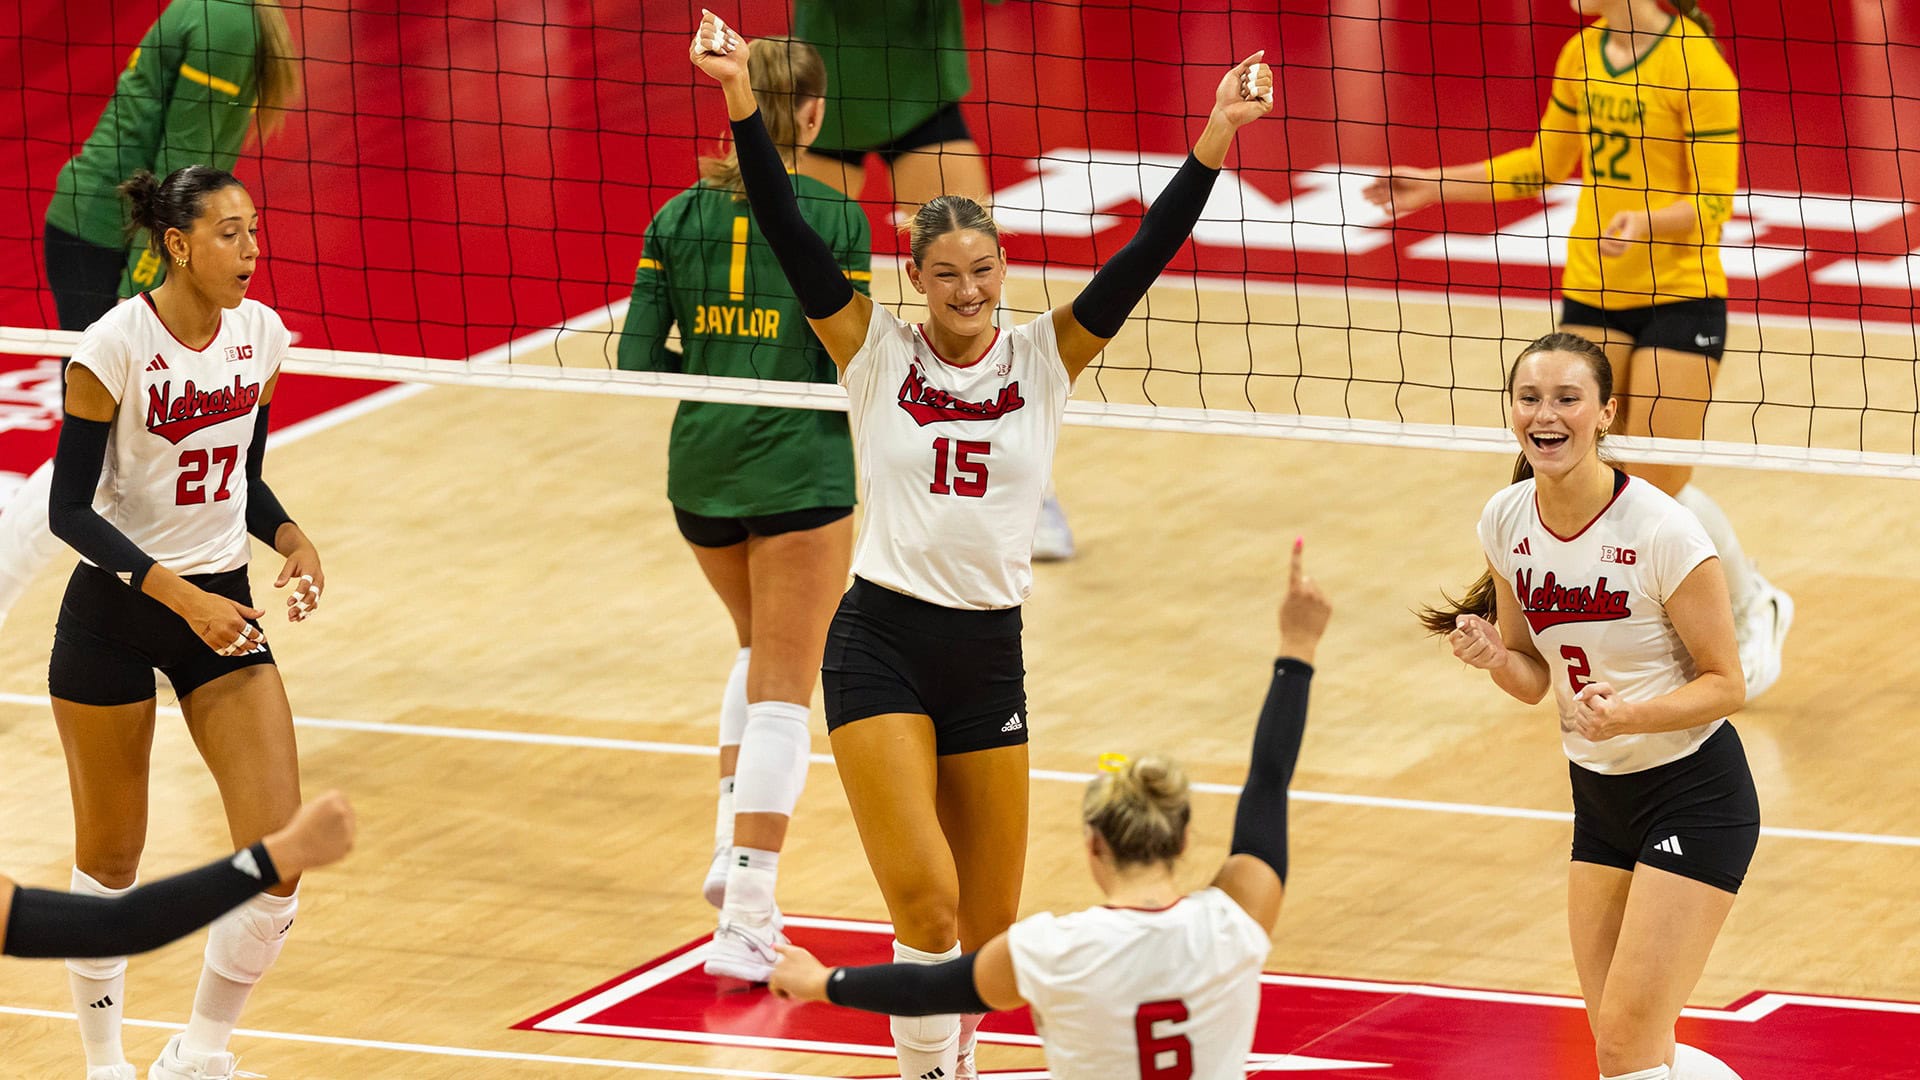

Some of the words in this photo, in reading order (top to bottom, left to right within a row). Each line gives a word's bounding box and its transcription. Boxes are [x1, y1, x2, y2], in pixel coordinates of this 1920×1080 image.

[1589, 128, 1631, 181] 22
[729, 216, 749, 301] 1
[224, 345, 253, 362] BIG
[146, 374, 260, 429] Nebraska
[175, 444, 239, 506] 27
[929, 436, 992, 498] 15
[1600, 545, 1637, 566] BIG
[1516, 567, 1631, 617] Nebraska
[1559, 644, 1597, 695] 2
[1134, 998, 1194, 1080] 6
